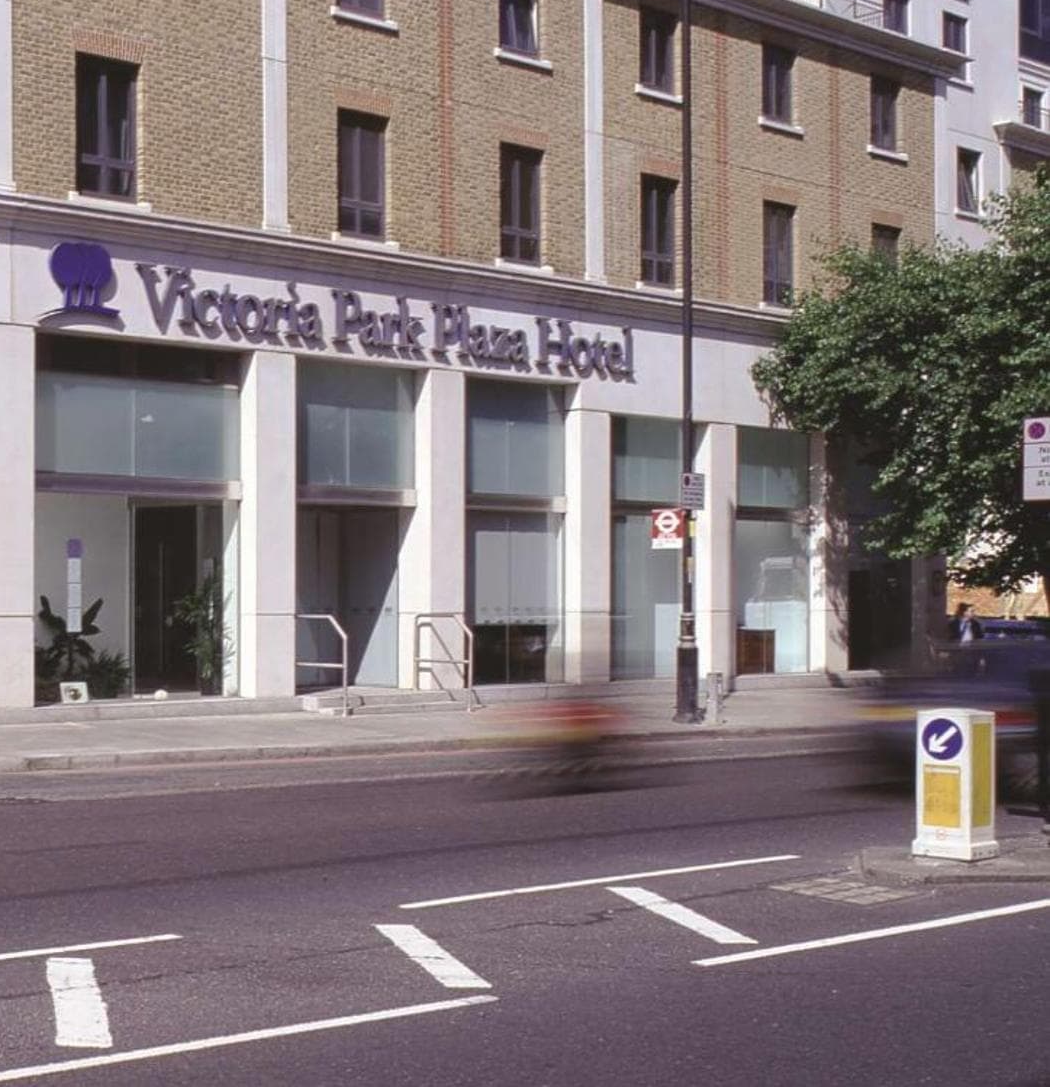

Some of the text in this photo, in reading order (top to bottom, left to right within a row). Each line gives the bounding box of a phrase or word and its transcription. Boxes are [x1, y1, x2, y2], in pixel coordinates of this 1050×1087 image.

[135, 263, 635, 380] Victoria Park Plaza Hotel
